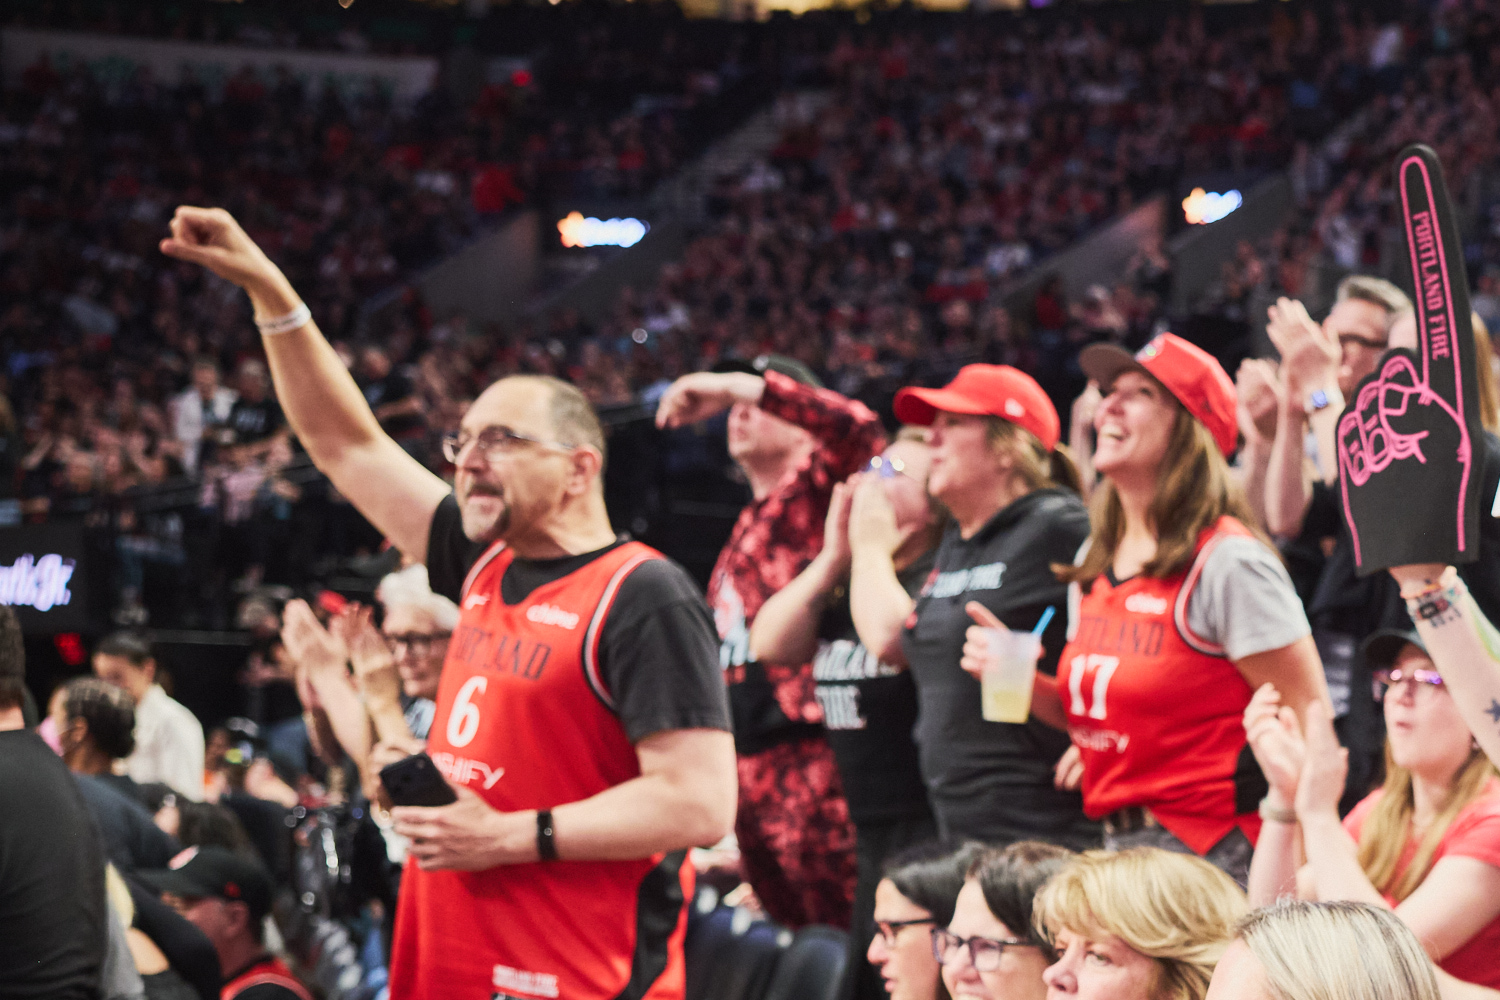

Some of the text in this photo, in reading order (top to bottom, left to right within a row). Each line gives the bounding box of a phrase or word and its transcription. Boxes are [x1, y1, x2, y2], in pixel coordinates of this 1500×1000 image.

[1412, 210, 1450, 361] PORTLAND FIRE
[446, 675, 488, 748] 6
[1068, 653, 1120, 721] 17
